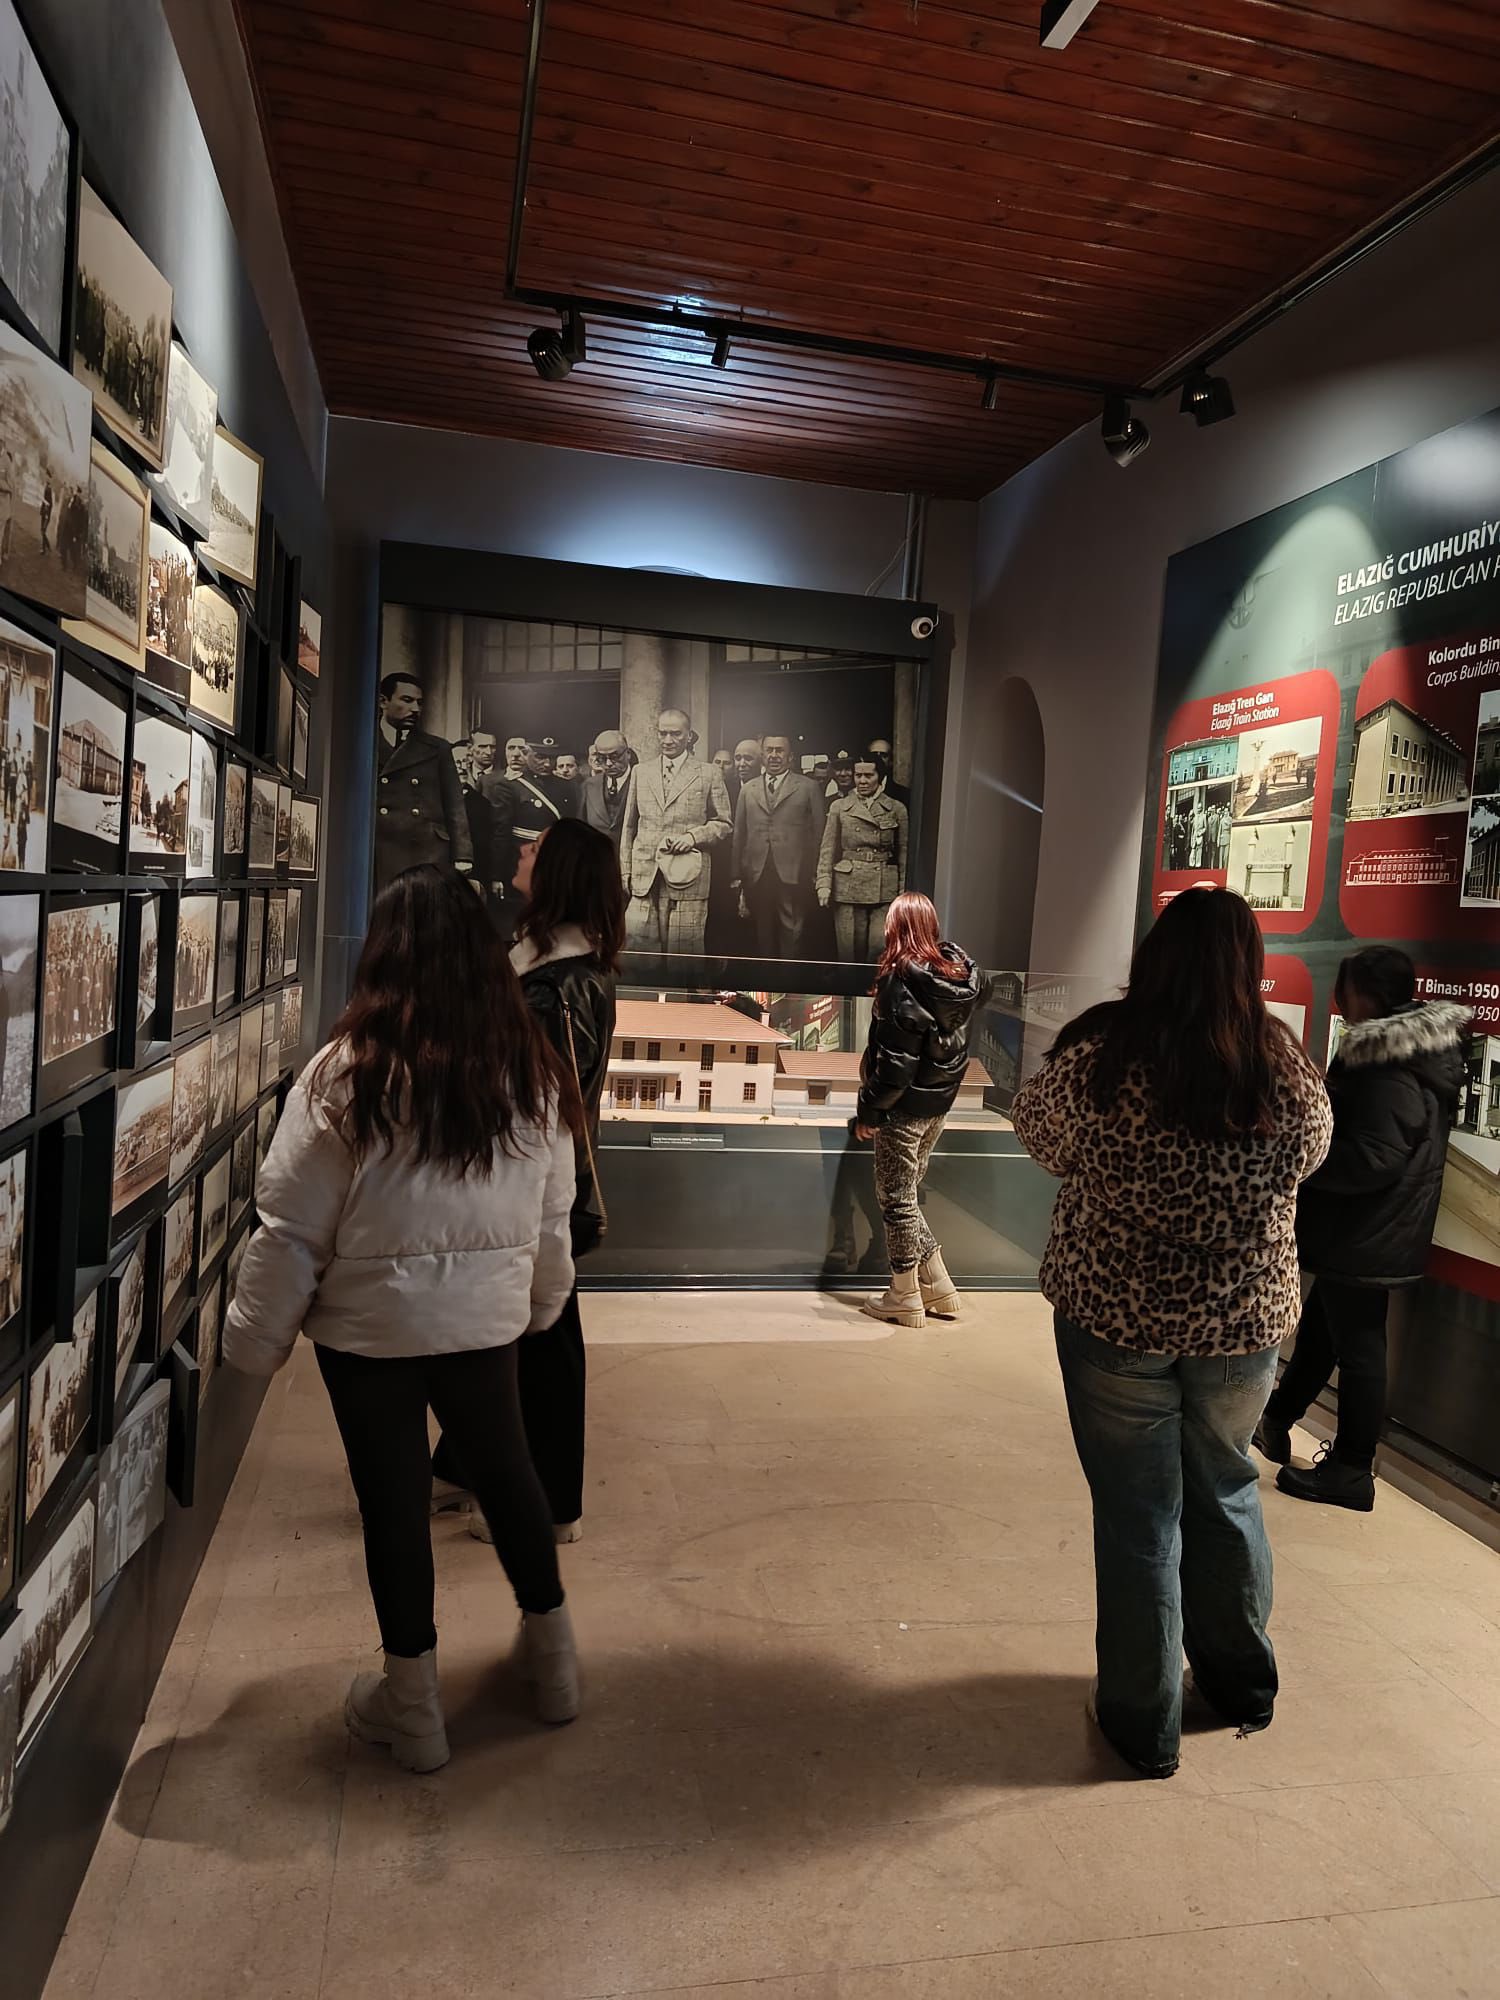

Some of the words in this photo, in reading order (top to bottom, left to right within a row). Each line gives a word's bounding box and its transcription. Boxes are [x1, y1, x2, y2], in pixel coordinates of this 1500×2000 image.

[1336, 554, 1394, 596] ELAZIĞ
[1397, 520, 1500, 575] CUMHURİY
[1333, 591, 1385, 626] ELAZIG
[1386, 557, 1492, 610] REPUBLICAN
[1428, 641, 1477, 666] Kolordu
[1427, 670, 1458, 688] Corps
[1459, 658, 1500, 681] Buildin
[1212, 699, 1236, 716] Elazığ
[1236, 696, 1255, 710] Tren
[1232, 711, 1251, 726] Train
[1251, 706, 1280, 722] Station
[1415, 977, 1425, 993] T
[1425, 978, 1500, 1000] Binası-1950
[1471, 1005, 1500, 1022] 1950
